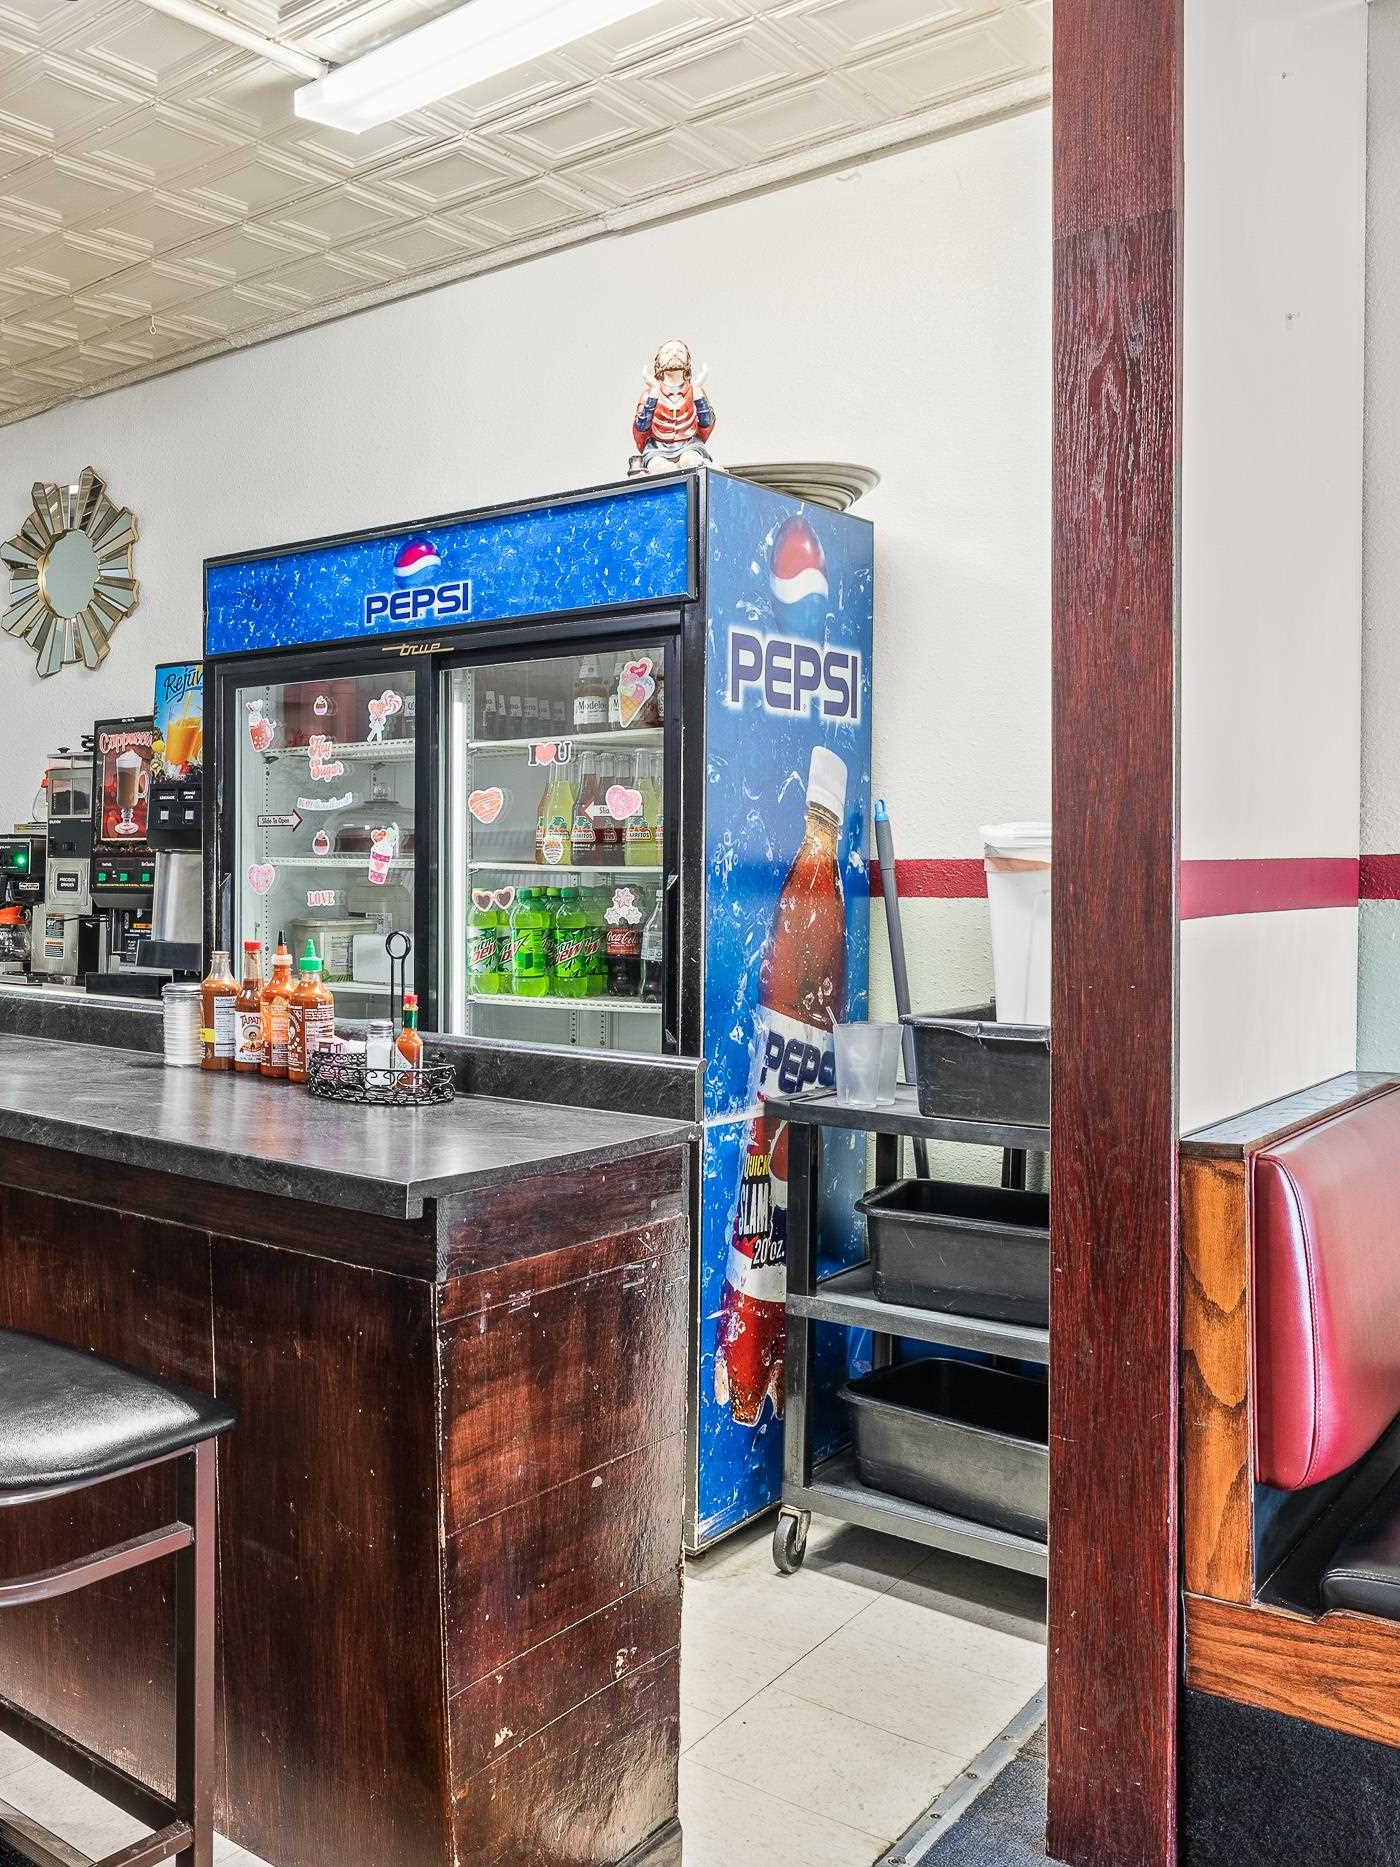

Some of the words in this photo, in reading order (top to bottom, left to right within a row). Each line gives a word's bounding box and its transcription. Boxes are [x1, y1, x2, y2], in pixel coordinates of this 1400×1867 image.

[365, 582, 470, 625] PEPSI
[391, 642, 447, 657] true
[164, 665, 204, 703] Rejuv
[731, 631, 859, 719] PEPSI
[553, 741, 572, 763] U
[240, 1014, 263, 1028] TAPAT
[738, 1183, 771, 1237] SLAM
[752, 1238, 769, 1265] 20
